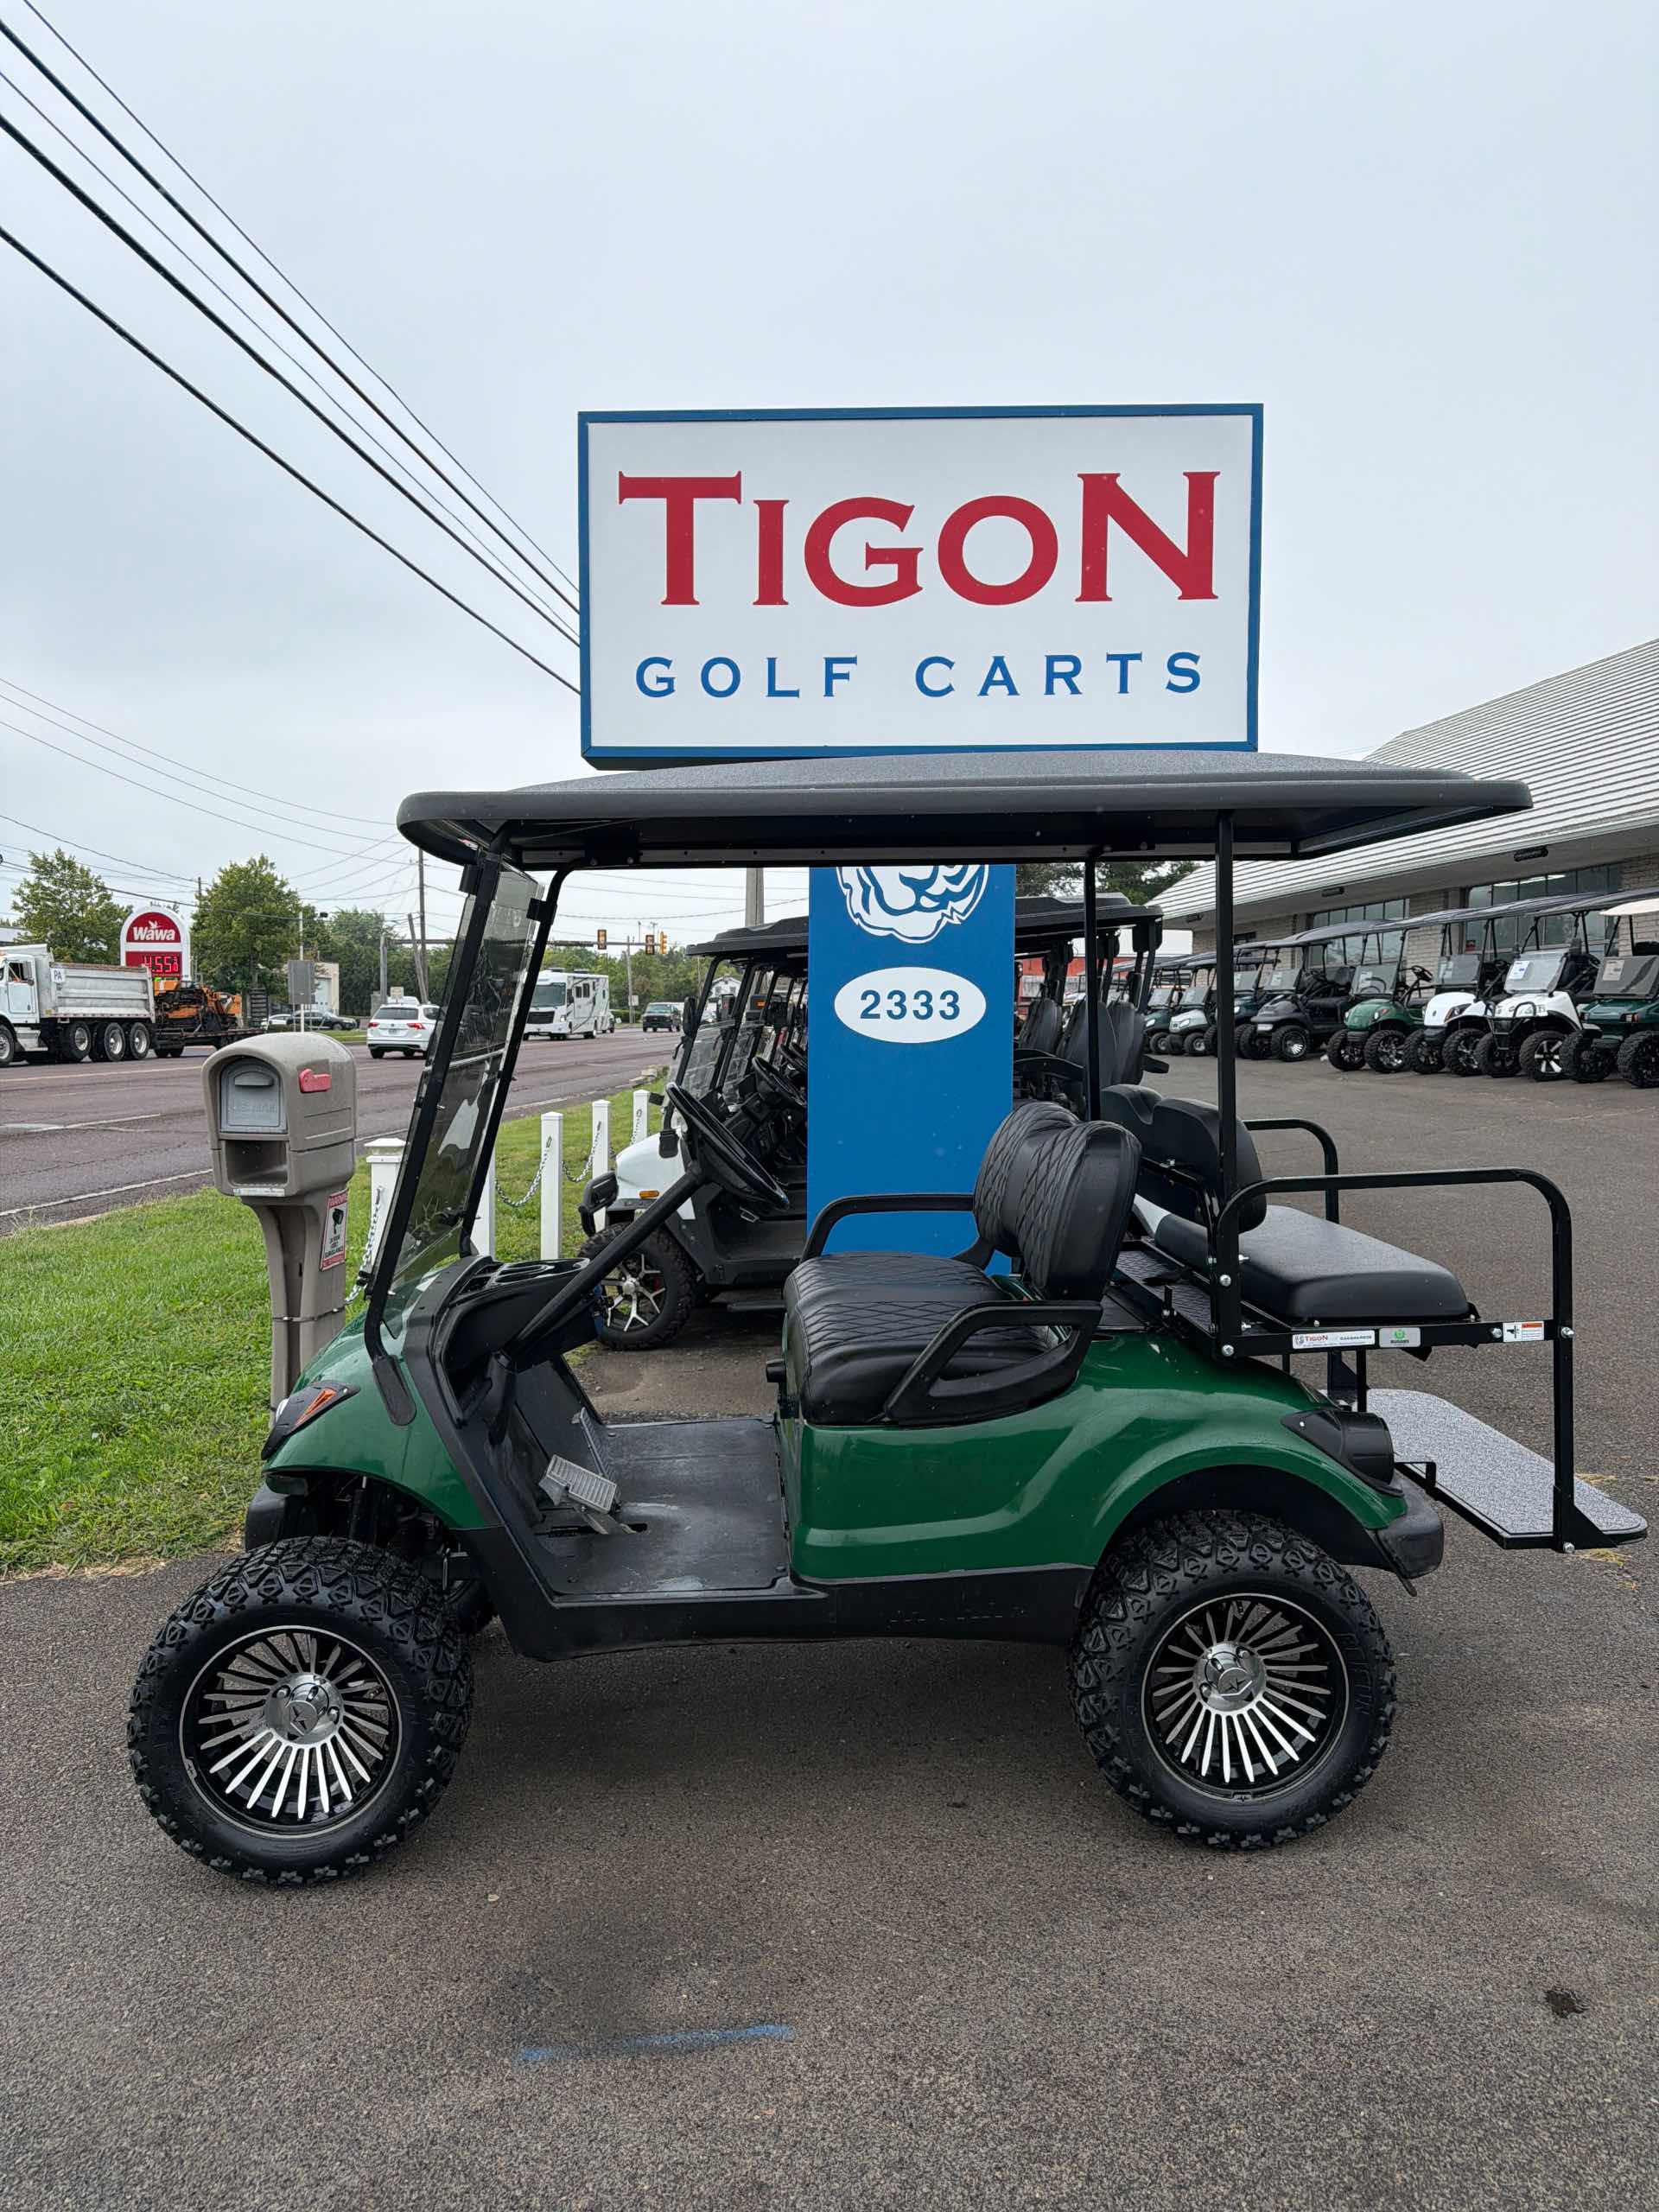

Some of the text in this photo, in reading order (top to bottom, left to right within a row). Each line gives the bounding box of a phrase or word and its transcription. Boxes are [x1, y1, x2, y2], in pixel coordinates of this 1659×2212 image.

[618, 470, 1221, 607] TIGON
[635, 651, 1202, 698] GOLF CARTS
[133, 926, 175, 941] Wawa
[54, 969, 63, 982] PA
[860, 989, 961, 1020] 2333
